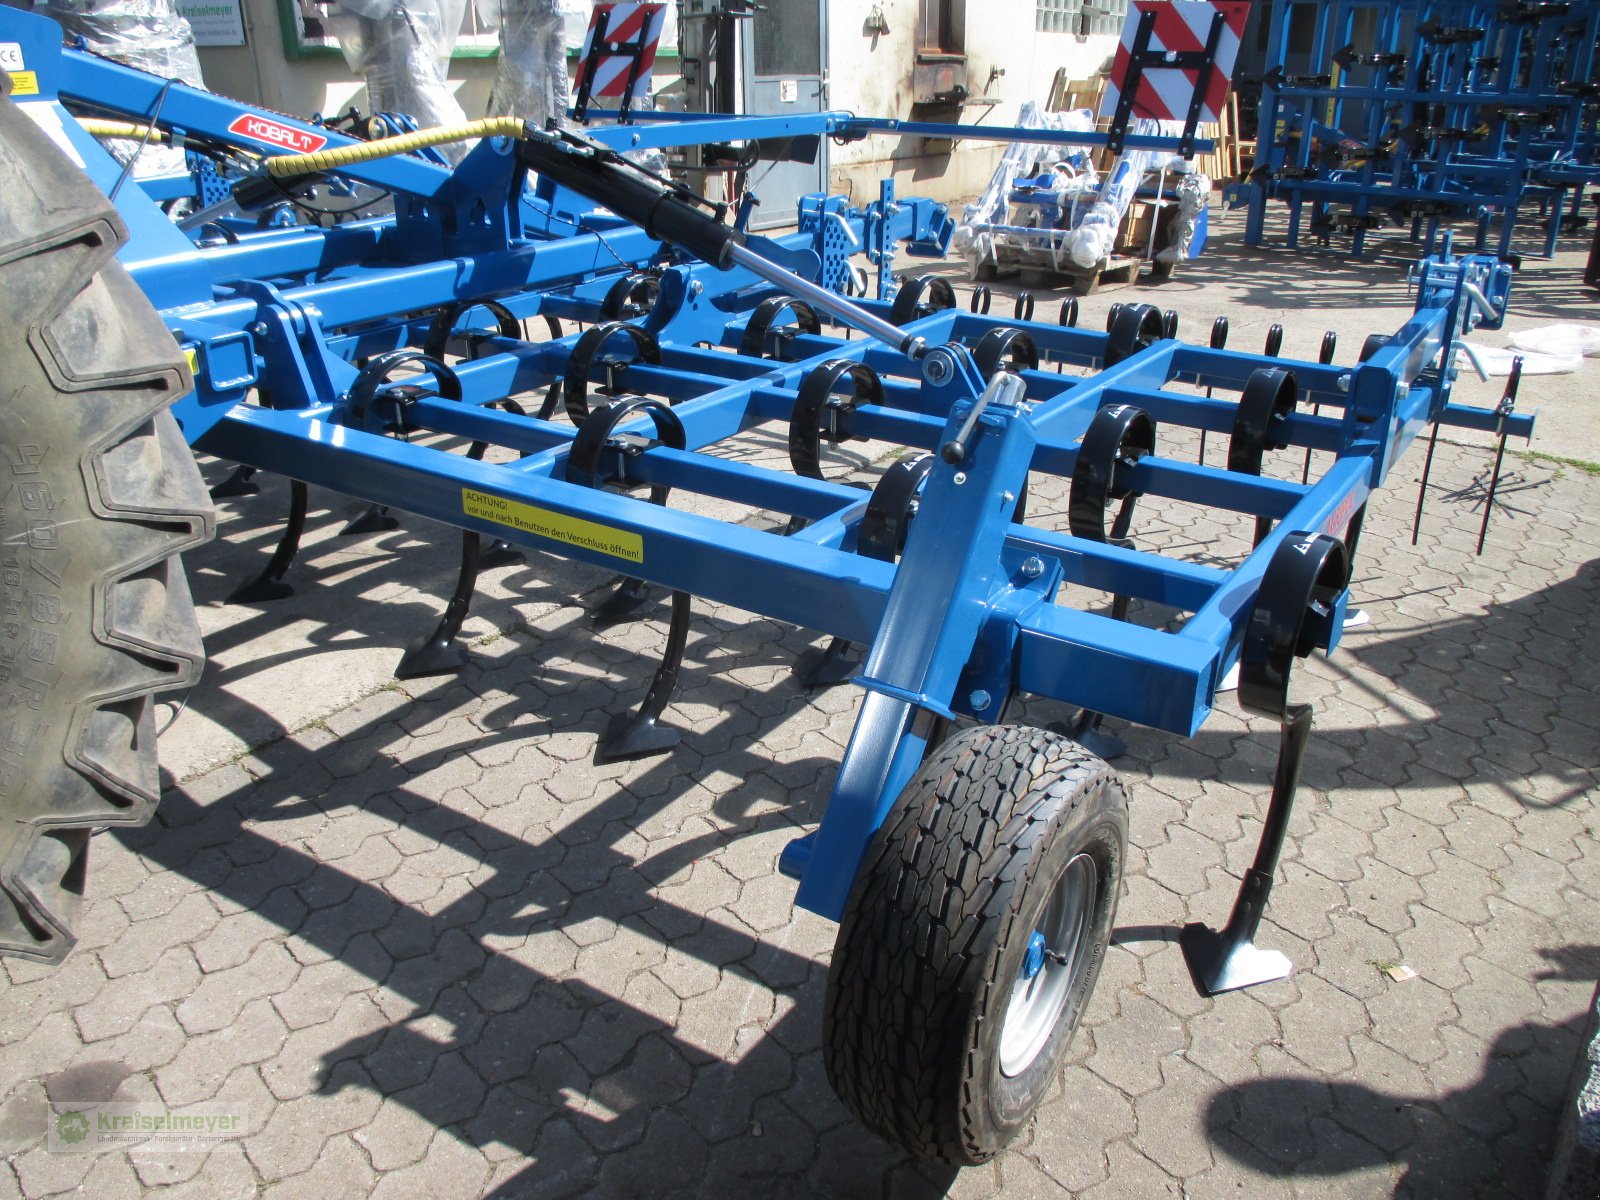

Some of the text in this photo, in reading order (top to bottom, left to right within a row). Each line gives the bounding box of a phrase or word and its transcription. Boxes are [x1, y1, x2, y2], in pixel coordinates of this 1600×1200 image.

[1, 50, 17, 62] CE
[247, 119, 312, 149] KOBALT
[466, 492, 508, 510] ACHTUNG!
[467, 506, 639, 560] vor und nach Benutzen den Verschluss öffnen!
